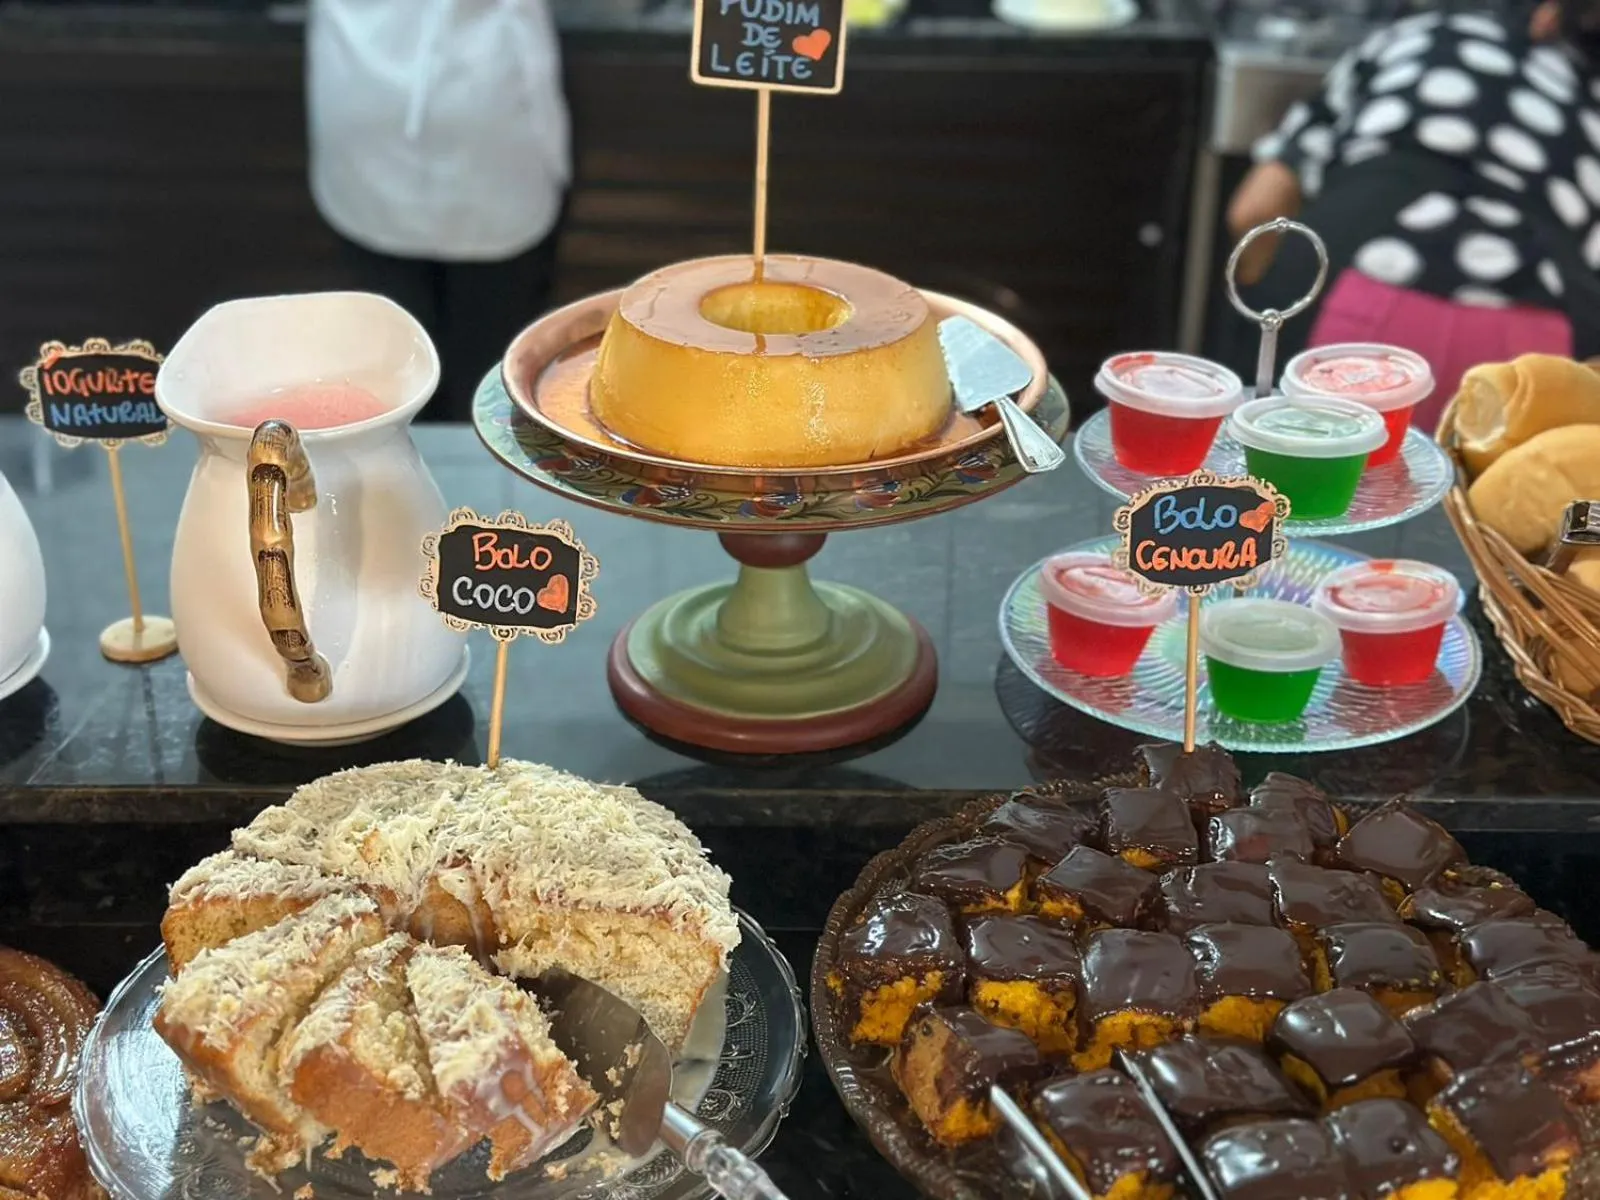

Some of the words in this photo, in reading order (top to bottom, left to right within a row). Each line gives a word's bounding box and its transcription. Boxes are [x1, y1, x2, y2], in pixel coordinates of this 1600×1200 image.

[742, 22, 782, 48] DE
[51, 400, 165, 426] NATURAL
[1135, 537, 1257, 571] CENOURA
[452, 576, 535, 614] COCO
